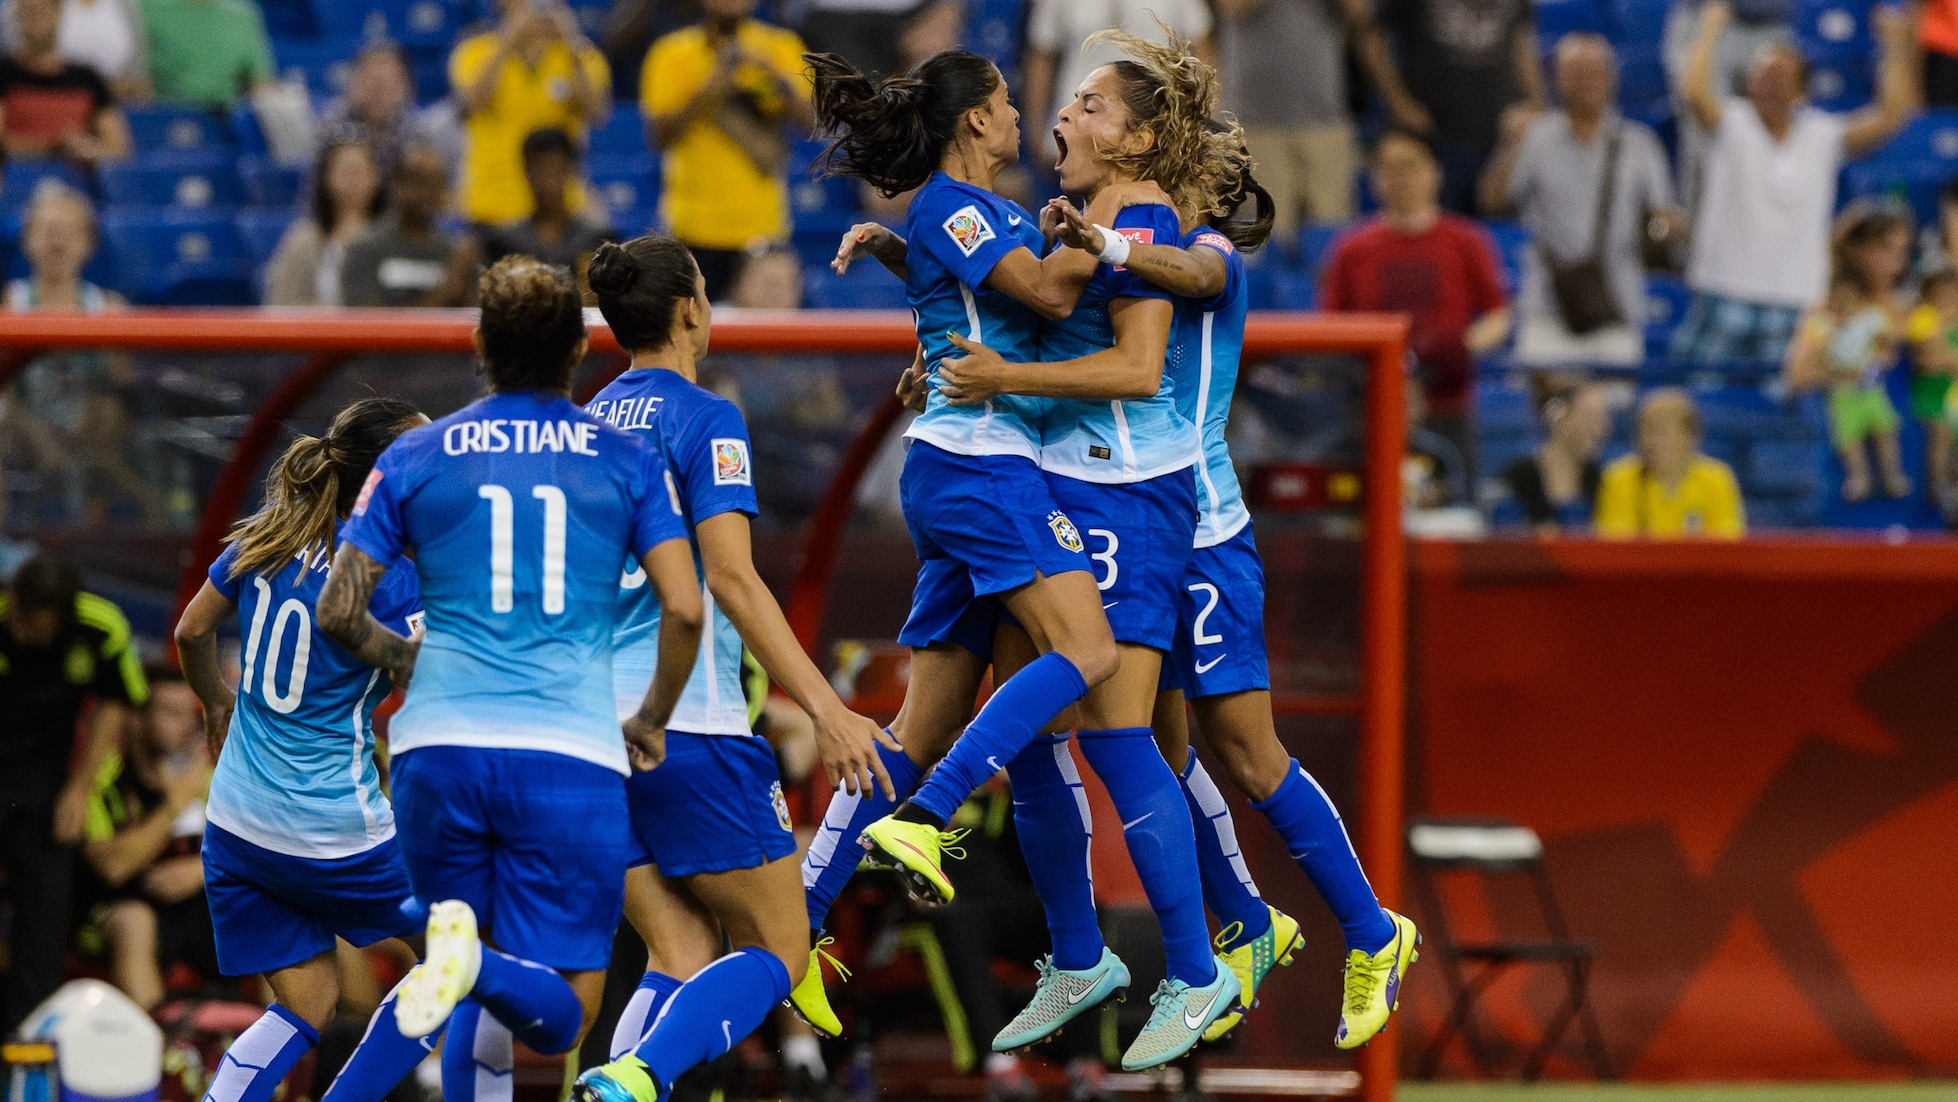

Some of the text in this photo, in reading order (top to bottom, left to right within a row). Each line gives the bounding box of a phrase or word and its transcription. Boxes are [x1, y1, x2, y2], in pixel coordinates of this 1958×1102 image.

[1125, 231, 1141, 241] IVE
[444, 419, 599, 457] CRISTIANE
[584, 397, 664, 431] FAELLE
[295, 538, 338, 579] RTA
[478, 484, 566, 615] 11
[1088, 528, 1119, 590] 3
[1188, 582, 1223, 645] 2
[243, 576, 311, 714] 10
